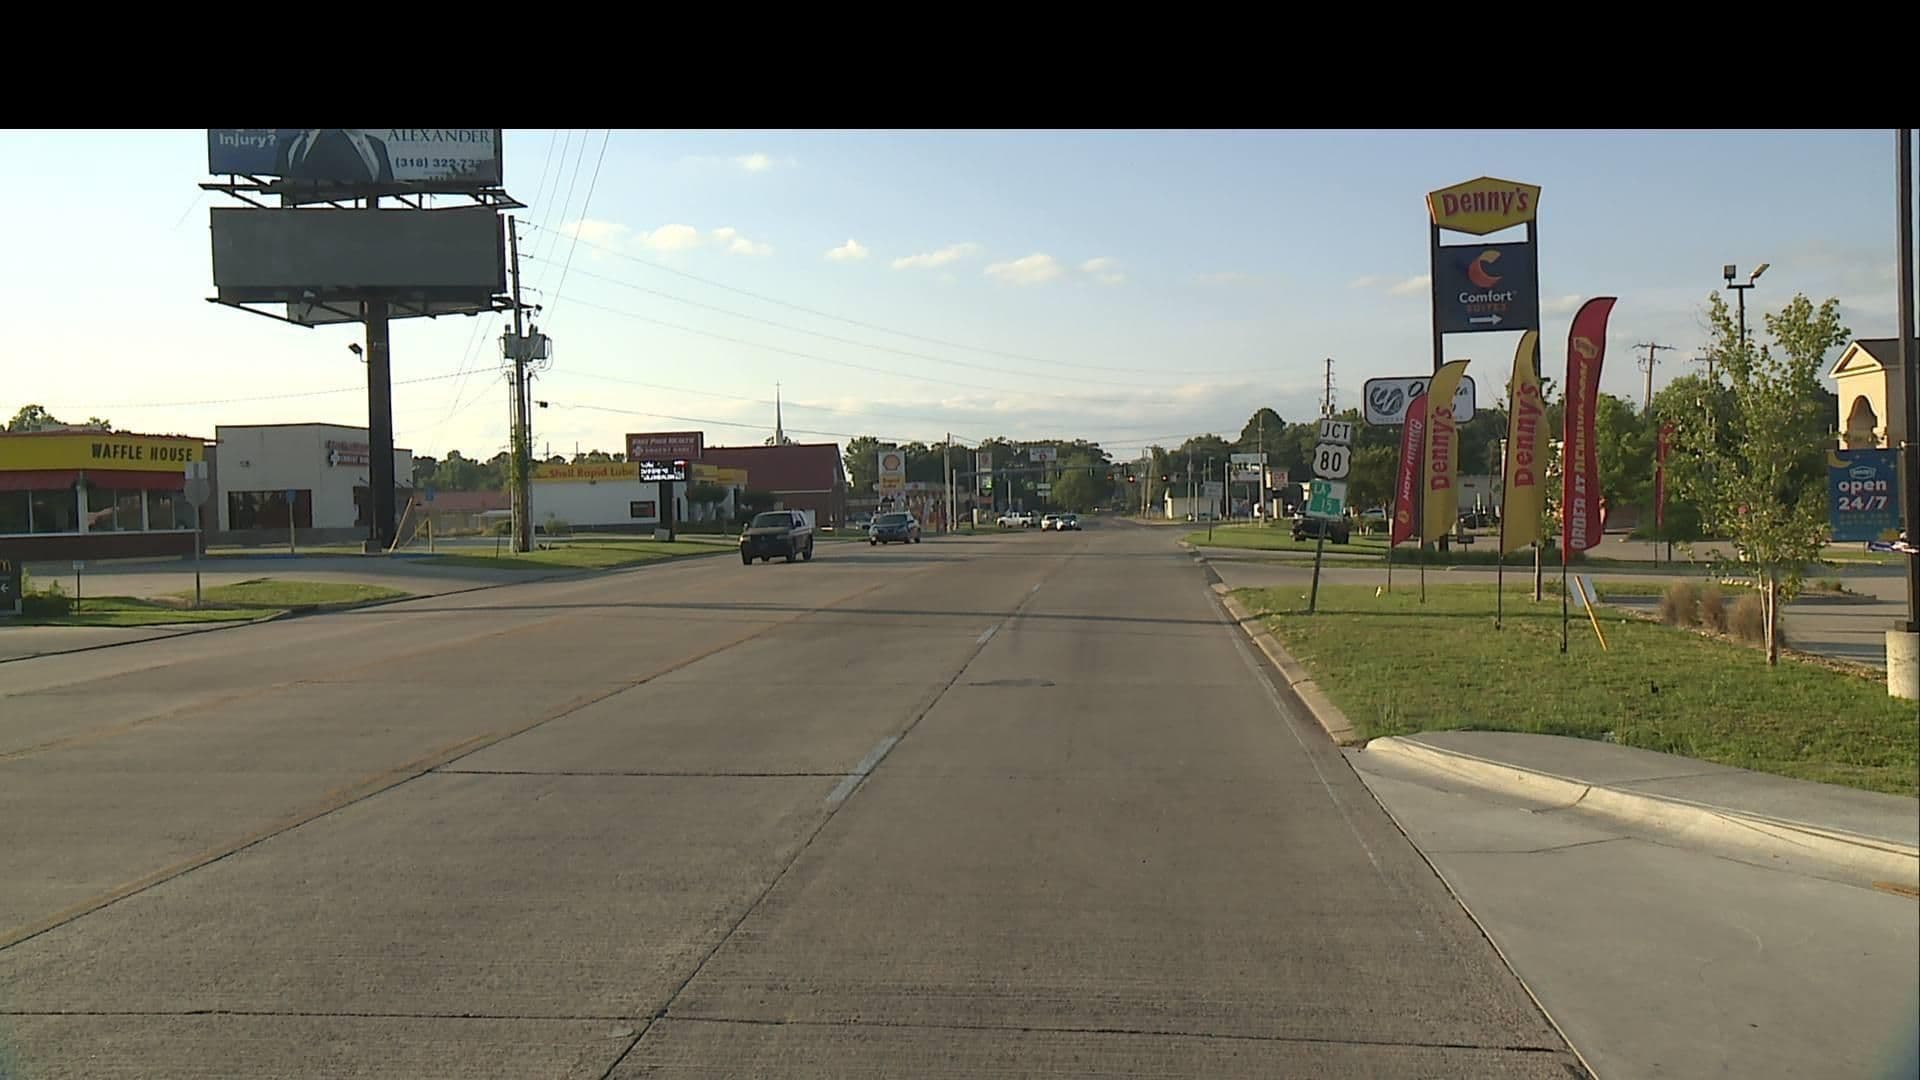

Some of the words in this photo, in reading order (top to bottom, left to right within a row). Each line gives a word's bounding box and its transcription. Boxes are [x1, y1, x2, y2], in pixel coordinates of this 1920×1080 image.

[218, 132, 277, 148] Injury?
[388, 129, 490, 143] ALEXANDER
[396, 157, 428, 168] (318)
[1442, 187, 1529, 217] Denny's
[1459, 290, 1513, 303] Comfort
[1322, 422, 1350, 439] JCT
[1514, 383, 1542, 488] Denny's
[92, 443, 143, 460] WAFFLE
[150, 446, 193, 462] HOUSE
[1431, 406, 1456, 491] Denny's
[1320, 450, 1342, 472] 80
[549, 467, 575, 477] Shell
[577, 467, 607, 479] Rapid
[610, 466, 635, 476] Lube
[1402, 467, 1412, 501] NOW
[1575, 473, 1586, 494] AT
[1838, 480, 1887, 495] open
[1839, 496, 1888, 511] 24/7
[1570, 497, 1587, 550] ORDER
